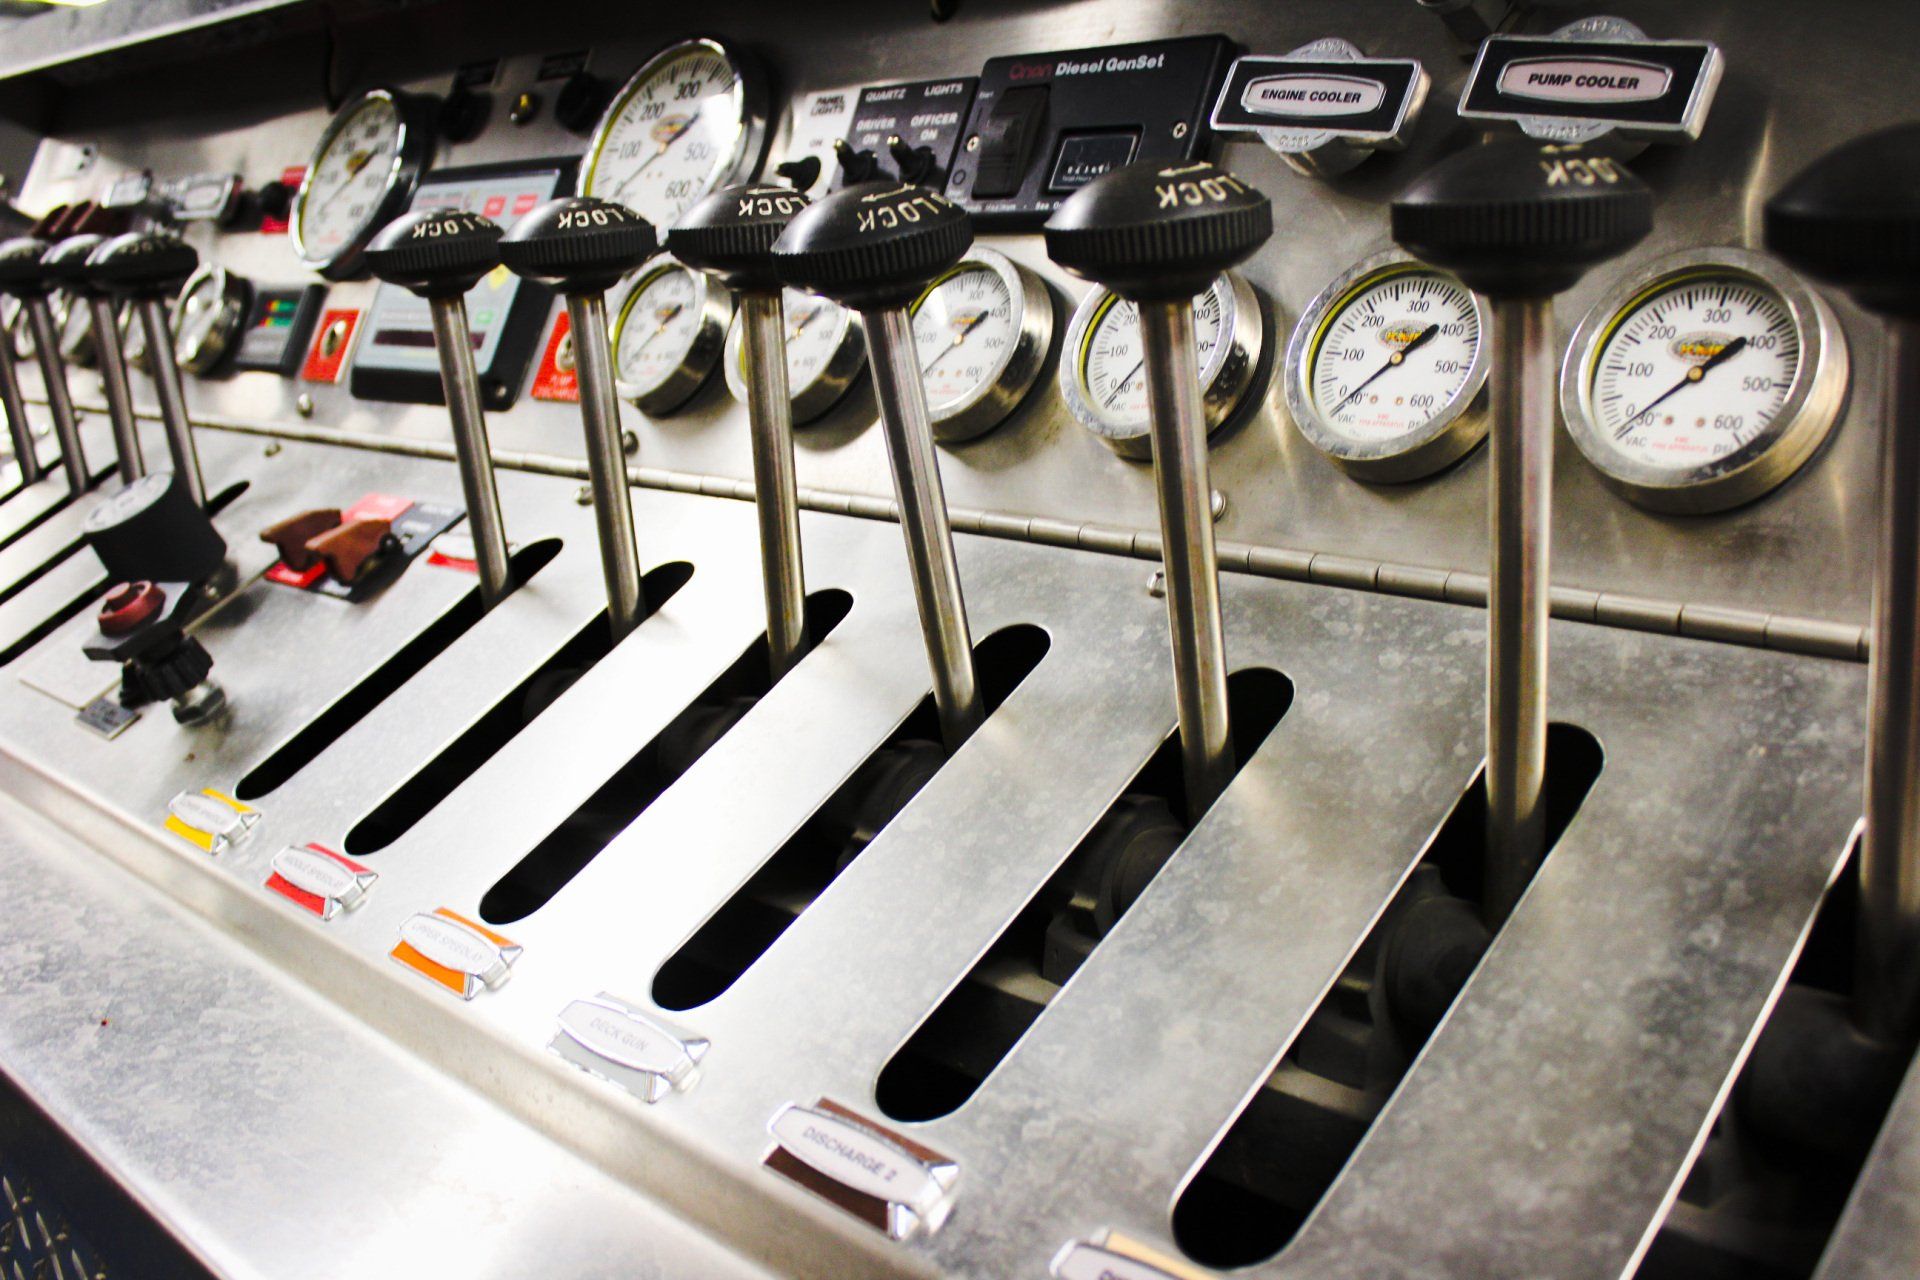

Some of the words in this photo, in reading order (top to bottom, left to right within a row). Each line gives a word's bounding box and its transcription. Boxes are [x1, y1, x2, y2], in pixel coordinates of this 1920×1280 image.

[1055, 59, 1104, 76] Diesel
[1106, 53, 1165, 72] GenSet
[1528, 73, 1572, 87] PUMP
[1575, 75, 1640, 90] COOLER
[674, 81, 701, 101] 300
[865, 88, 907, 103] QUARTZ
[924, 82, 964, 97] LIGHTS
[1261, 88, 1306, 101] ENGINE
[1309, 90, 1362, 104] COOLER
[815, 93, 845, 105] PANEL
[639, 101, 666, 120] 200
[810, 103, 845, 117] LIGHTS
[856, 117, 897, 132] DRIVER
[910, 112, 959, 127] OFFICER
[862, 133, 880, 146] ON
[920, 129, 939, 142] ON
[618, 140, 642, 160] 100
[683, 142, 710, 161] 500
[665, 178, 692, 198] 600
[1155, 173, 1244, 210] LOCK
[739, 196, 809, 217] LOCK
[558, 207, 625, 229] LOCK
[857, 197, 940, 233] LOCK
[412, 218, 475, 239] LOCK
[1193, 308, 1211, 320] 00
[1406, 300, 1430, 313] 300
[1361, 315, 1385, 328] 200
[1702, 308, 1731, 323] 300
[1440, 323, 1464, 337] 400
[1648, 325, 1676, 340] 200
[1747, 335, 1777, 350] 400
[1110, 345, 1129, 358] 100
[1342, 348, 1365, 362] 100
[1434, 360, 1459, 374] 500
[1627, 363, 1654, 377] 100
[1110, 377, 1118, 390] 0
[1339, 384, 1347, 397] 0
[1742, 376, 1773, 392] 500
[1409, 395, 1434, 408] 600
[1625, 403, 1635, 418] 0
[1337, 413, 1355, 424] VAC
[1714, 415, 1744, 430] 600
[1625, 435, 1648, 448] VAC
[589, 1016, 620, 1040] DECK
[621, 1033, 650, 1053] GUN
[802, 1125, 886, 1175] DISCHARGE
[883, 1167, 898, 1183] 2
